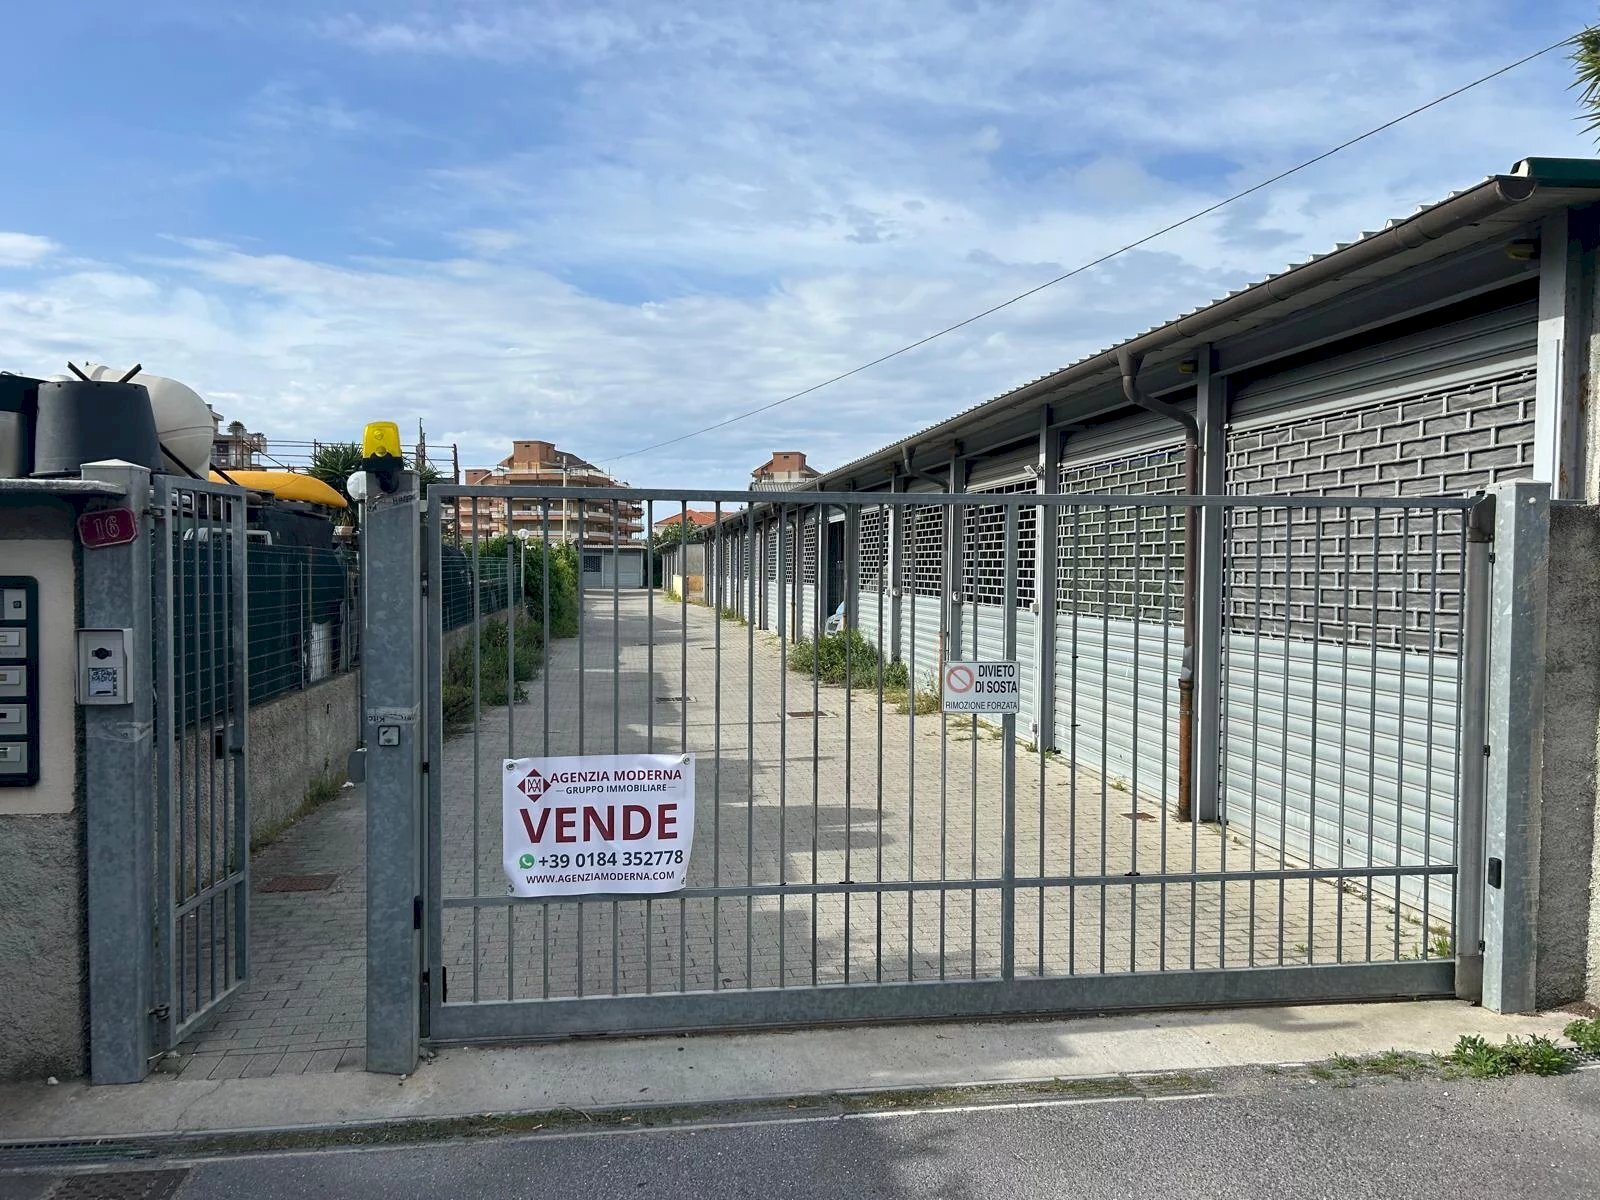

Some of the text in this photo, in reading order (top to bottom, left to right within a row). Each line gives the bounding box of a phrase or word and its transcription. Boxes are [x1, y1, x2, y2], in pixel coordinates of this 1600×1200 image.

[95, 516, 120, 539] 16
[978, 665, 1015, 677] DIVIETO
[975, 681, 1018, 693] DI SOSTA
[945, 701, 1018, 710] RIMOZIONE FORZATA
[550, 769, 682, 783] AGENZIA MODERNA
[565, 784, 667, 794] GRUPPO IMMOBILIARE
[519, 803, 678, 844] VENDE
[539, 850, 684, 868] +39 0184 352778
[526, 871, 675, 884] WWW.AGENZIAMODERNA.COM
